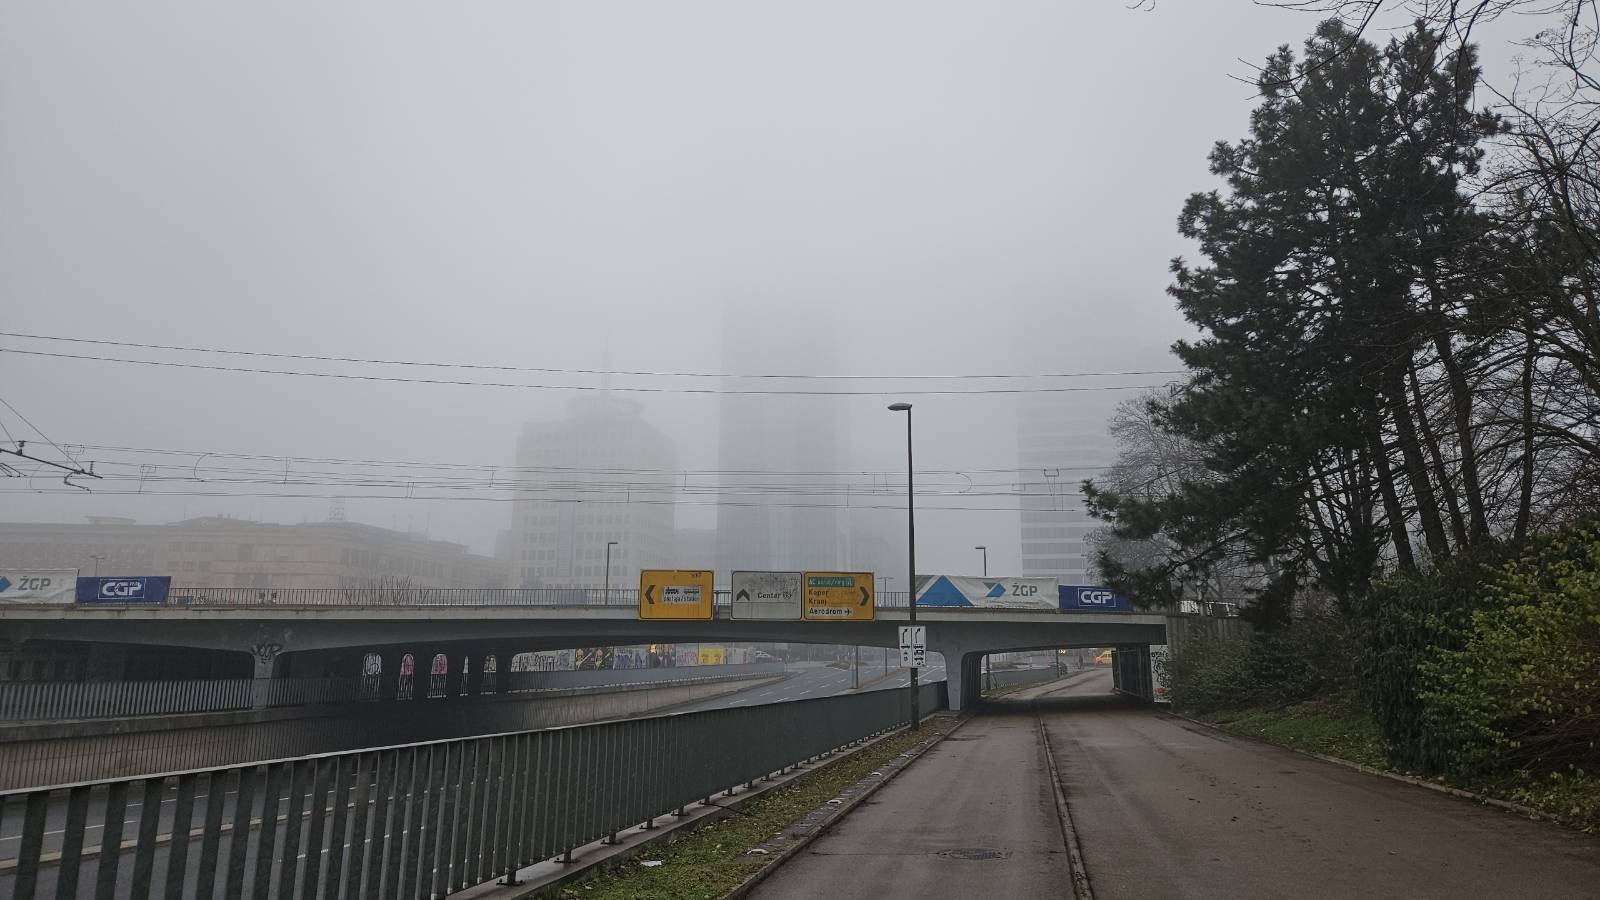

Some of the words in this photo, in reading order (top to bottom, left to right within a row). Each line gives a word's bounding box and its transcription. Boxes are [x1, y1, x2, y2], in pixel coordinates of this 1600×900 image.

[18, 575, 51, 591] ŽGP
[102, 581, 142, 596] CGP
[1012, 582, 1038, 597] ŽGP
[758, 591, 781, 599] Center
[1081, 591, 1112, 604] CGP
[809, 598, 827, 606] Kranj
[809, 607, 843, 615] Aerodrom
